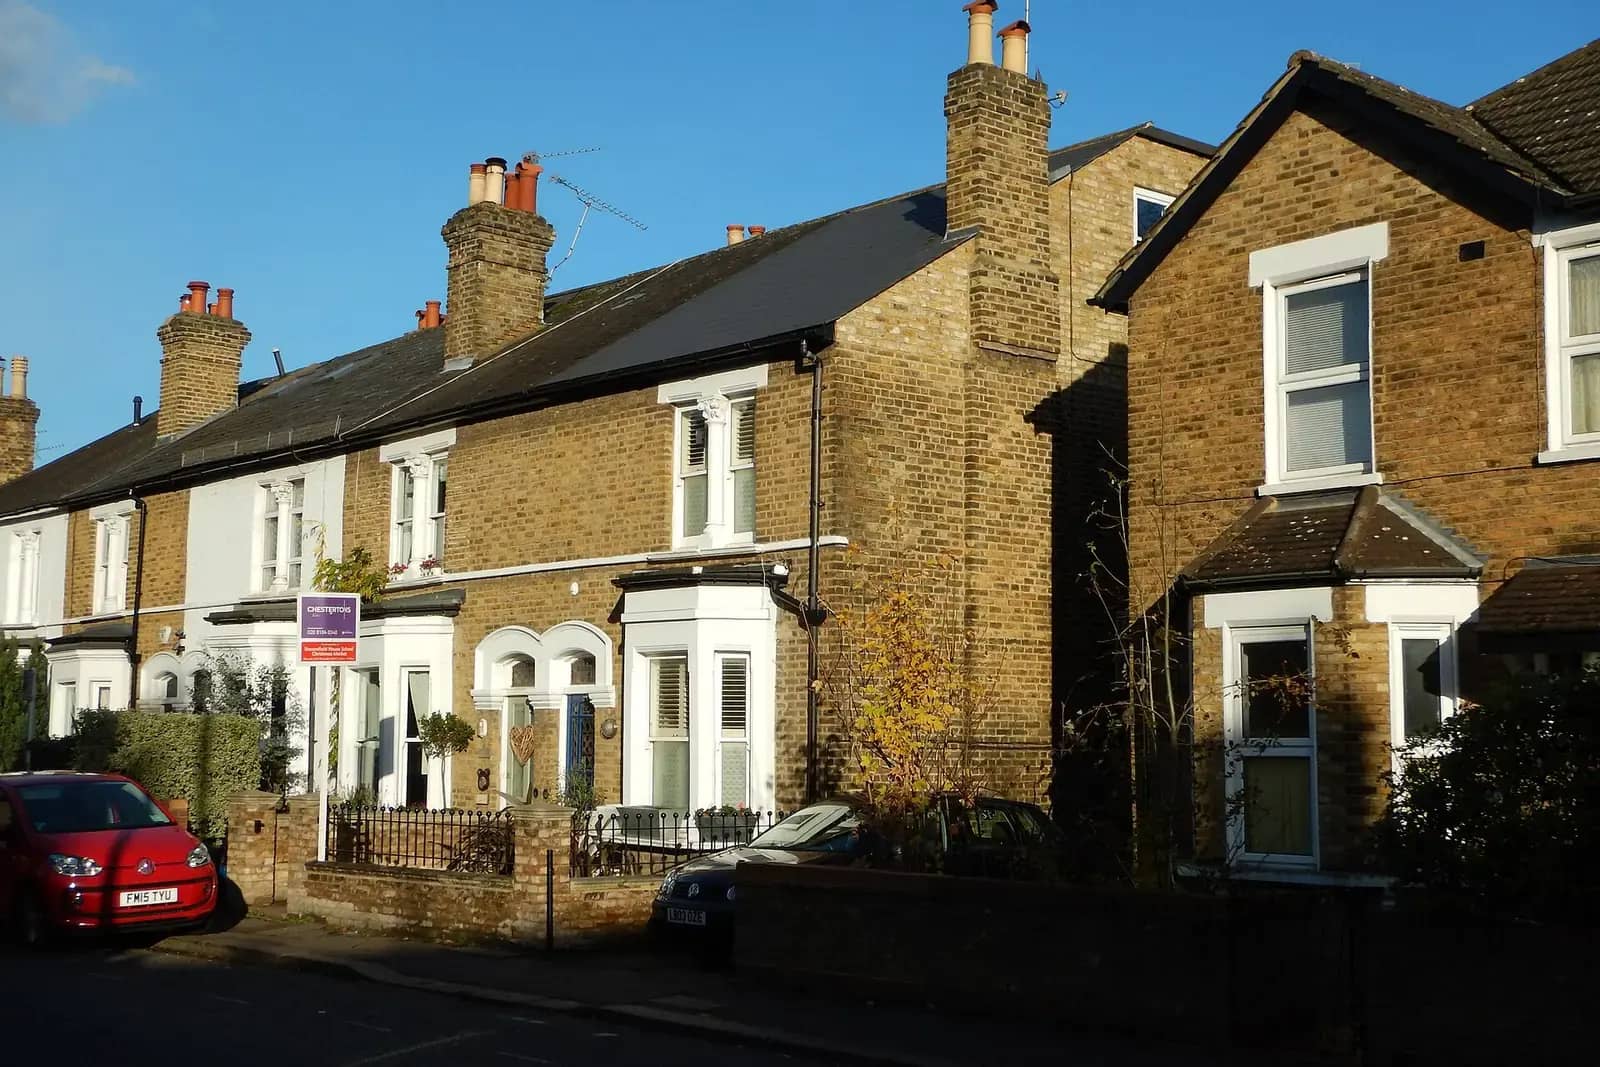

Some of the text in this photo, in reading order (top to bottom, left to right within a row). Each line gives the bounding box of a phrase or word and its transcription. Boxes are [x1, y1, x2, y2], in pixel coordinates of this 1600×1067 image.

[307, 606, 351, 614] CHESTERTONS
[126, 890, 172, 904] FM15 TYU
